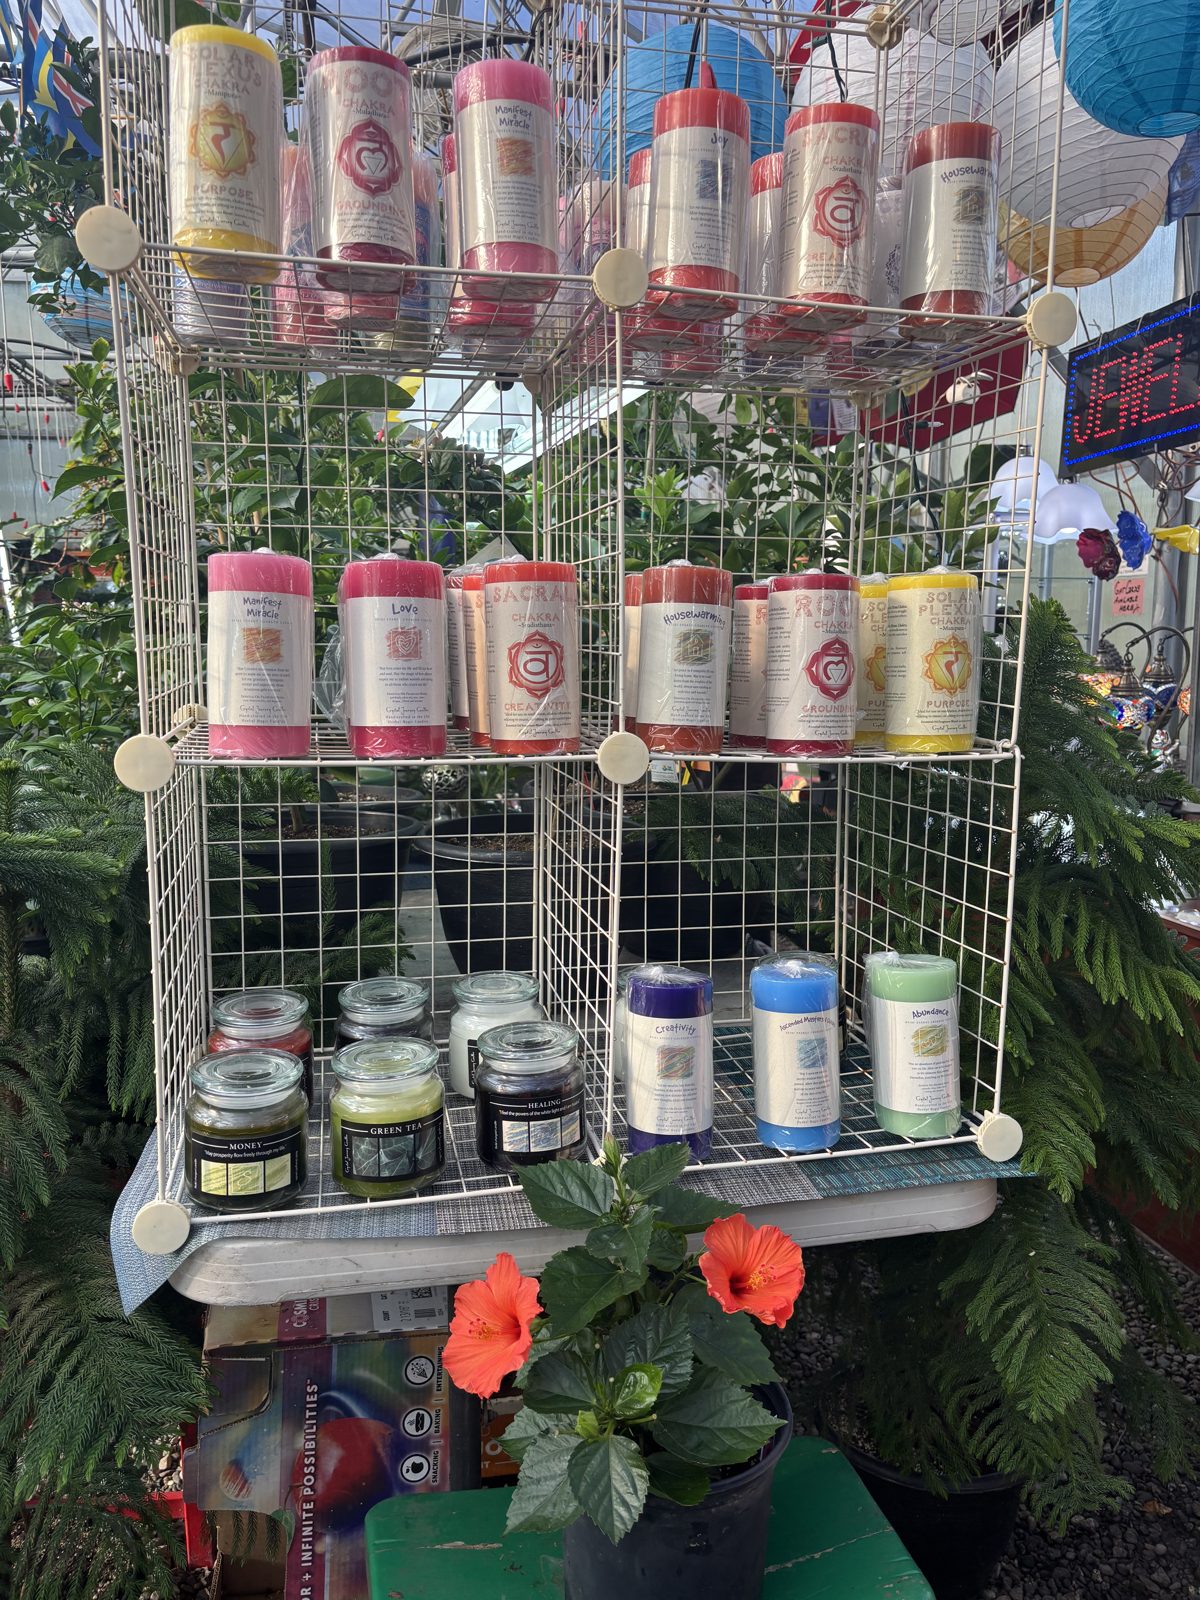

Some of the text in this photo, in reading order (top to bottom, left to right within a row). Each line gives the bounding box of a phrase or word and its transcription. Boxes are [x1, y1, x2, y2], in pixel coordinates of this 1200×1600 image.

[495, 105, 532, 118] Manifest
[499, 117, 530, 130] Miracle
[711, 132, 729, 149] Joy
[243, 596, 282, 610] Manifest
[392, 603, 418, 615] Love
[247, 608, 279, 620] Miracle
[511, 613, 560, 622] CHAKRA
[664, 610, 726, 630] Housewarming
[912, 1008, 950, 1019] Abundance
[655, 1023, 697, 1036] Creativity
[528, 1098, 561, 1109] HEALING
[370, 1123, 422, 1135] GREEN TEA
[229, 1142, 262, 1150] MONEY
[303, 1384, 318, 1495] POSSIBILITIES
[301, 1501, 314, 1567] INFINITE
